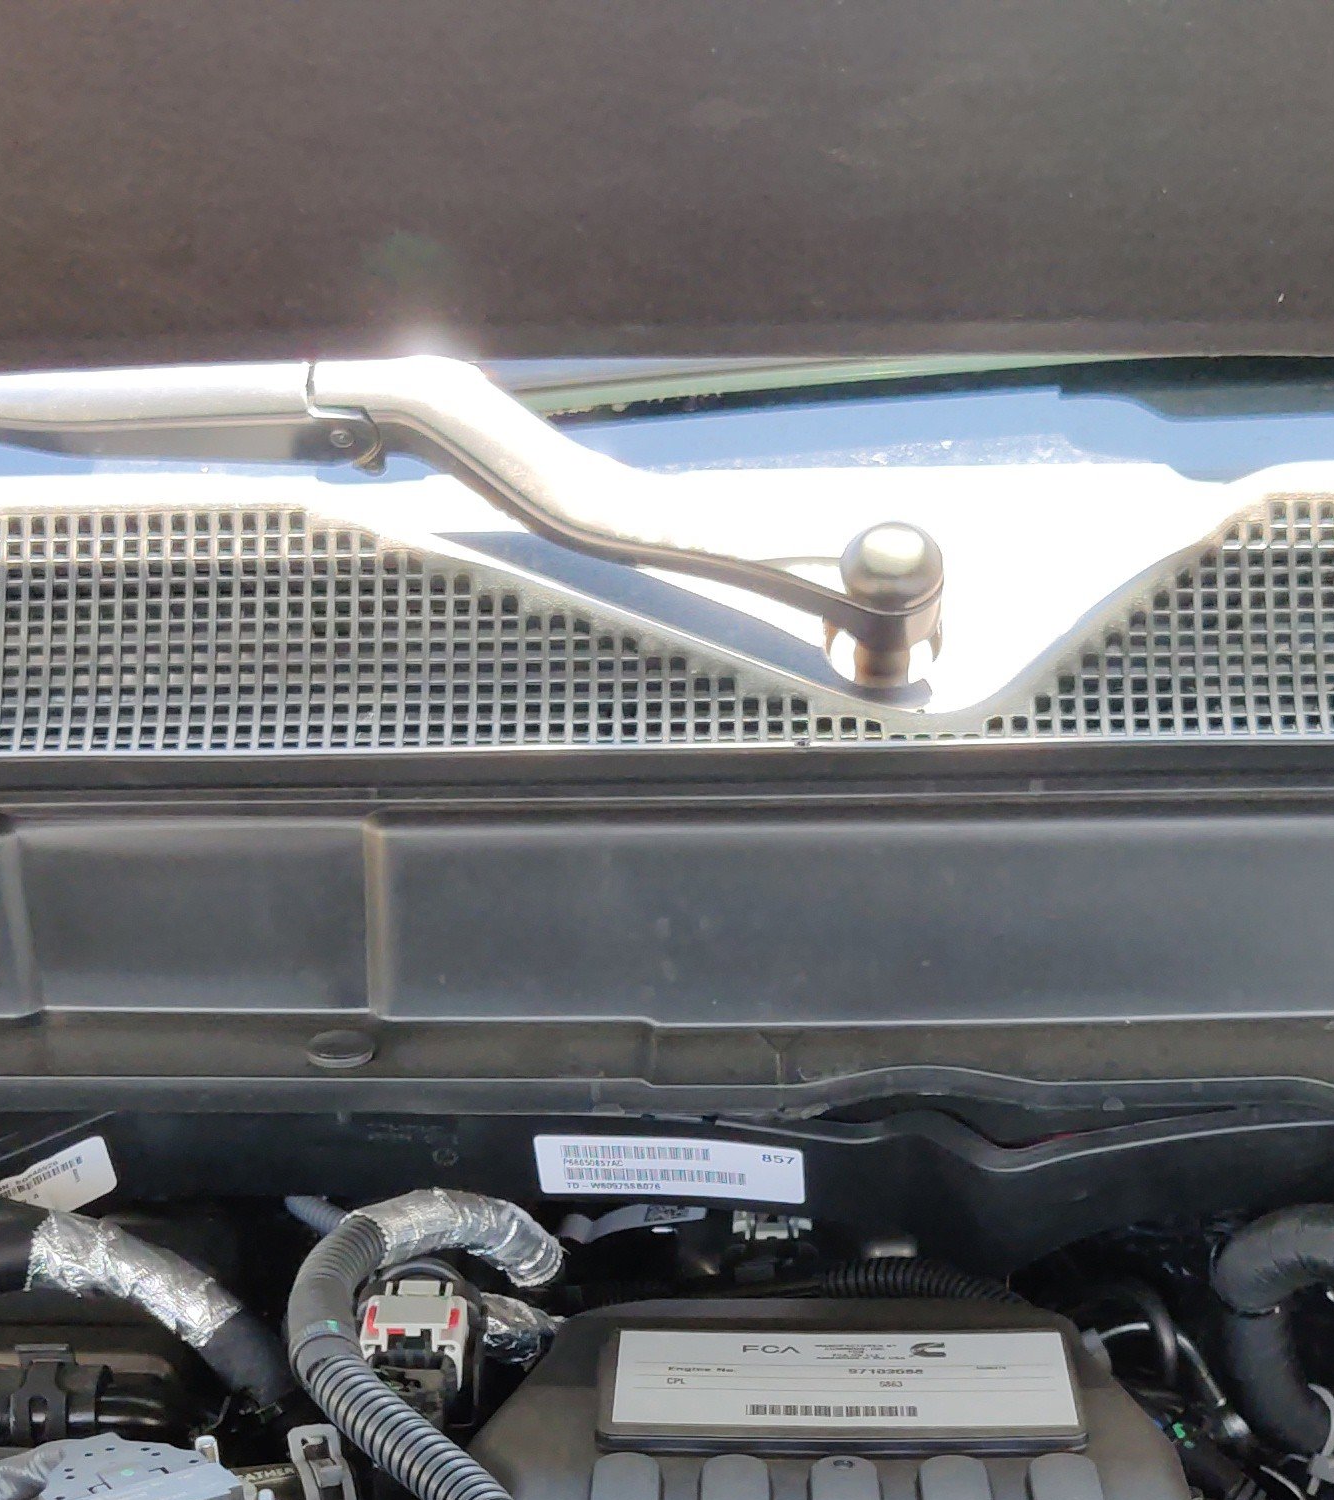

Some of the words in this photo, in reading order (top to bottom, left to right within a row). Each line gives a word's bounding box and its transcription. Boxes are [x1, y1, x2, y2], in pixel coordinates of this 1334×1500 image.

[761, 1152, 796, 1165] 857
[742, 1343, 801, 1354] FCA
[666, 1377, 686, 1385] CPL
